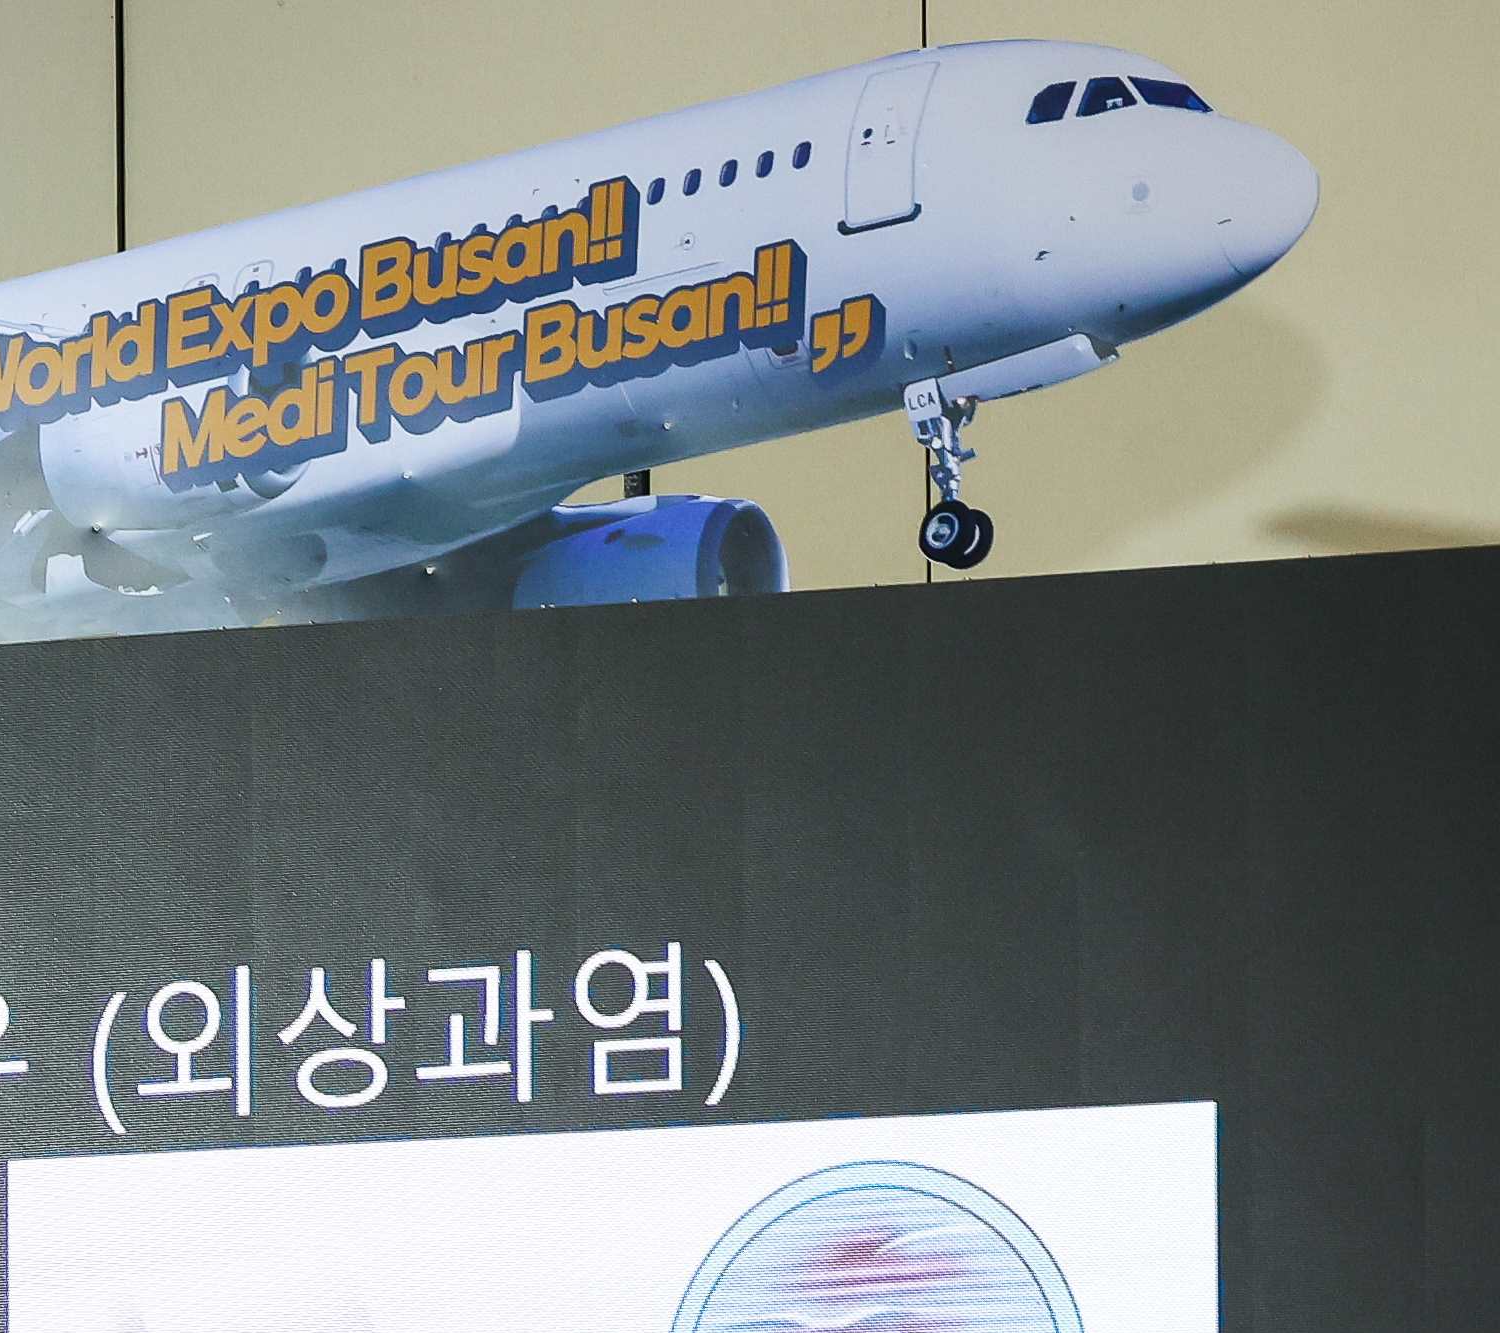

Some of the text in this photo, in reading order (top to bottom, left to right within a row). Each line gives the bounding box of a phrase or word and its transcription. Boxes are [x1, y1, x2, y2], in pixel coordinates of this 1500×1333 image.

[165, 272, 351, 369] Expo
[360, 179, 628, 321] Busan!!
[161, 358, 336, 476] Medi
[351, 332, 522, 427] Tour
[92, 941, 742, 1135] (외상과염)
